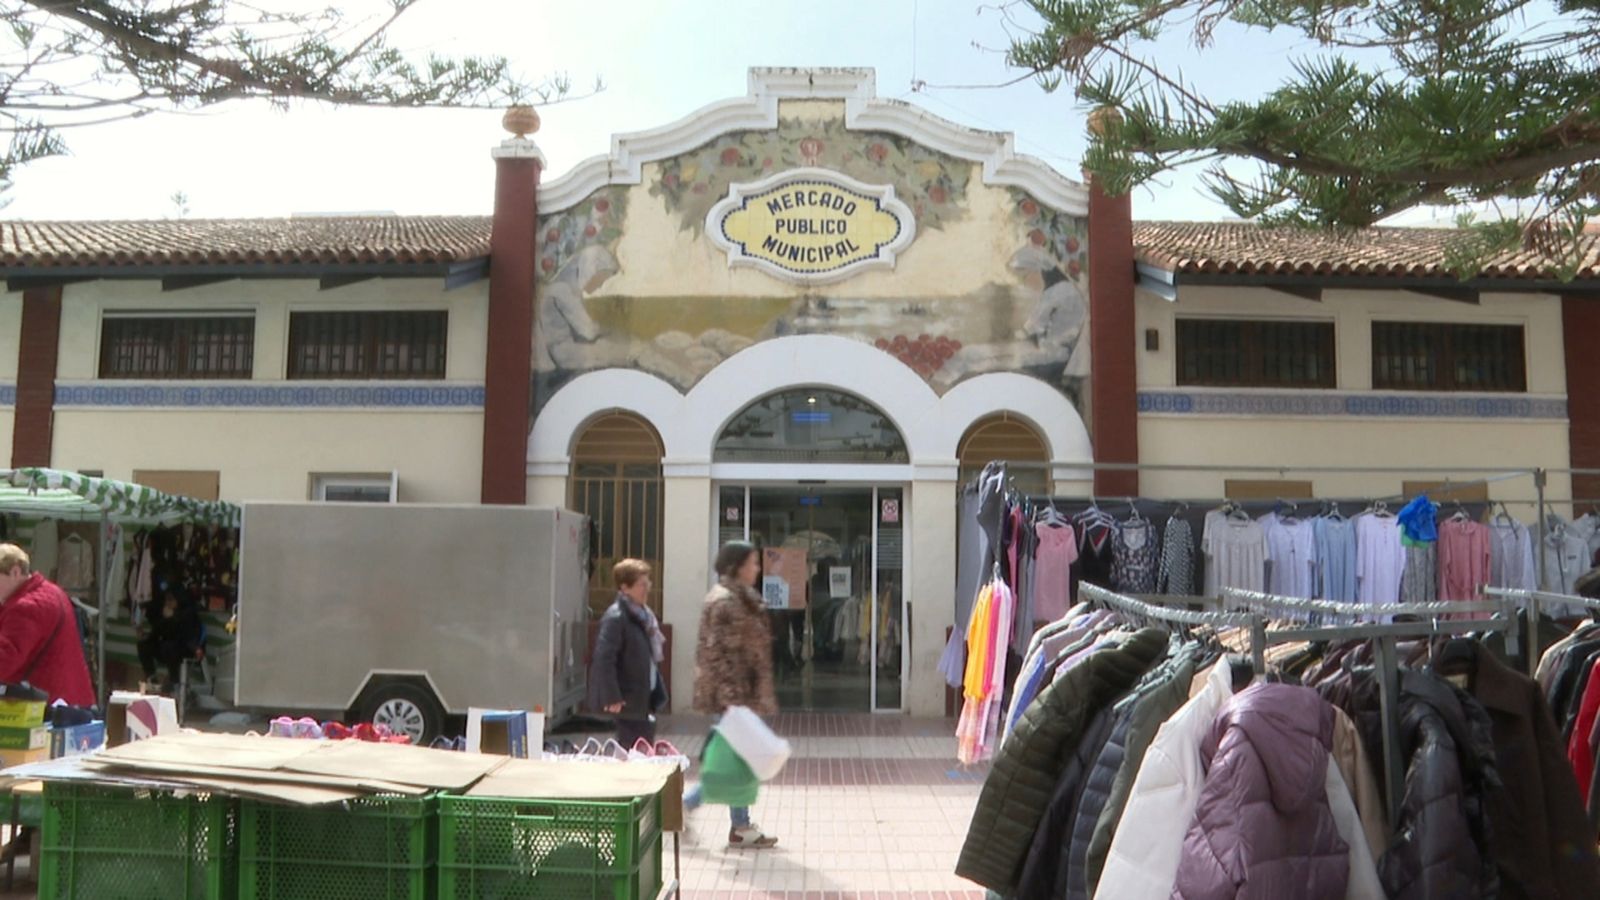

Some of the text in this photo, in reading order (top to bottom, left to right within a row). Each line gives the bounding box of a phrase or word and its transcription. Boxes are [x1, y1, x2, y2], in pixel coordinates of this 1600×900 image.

[767, 190, 857, 216] MERCADO
[775, 218, 847, 234] PUBLICO
[762, 235, 860, 263] MUNICIPAL
